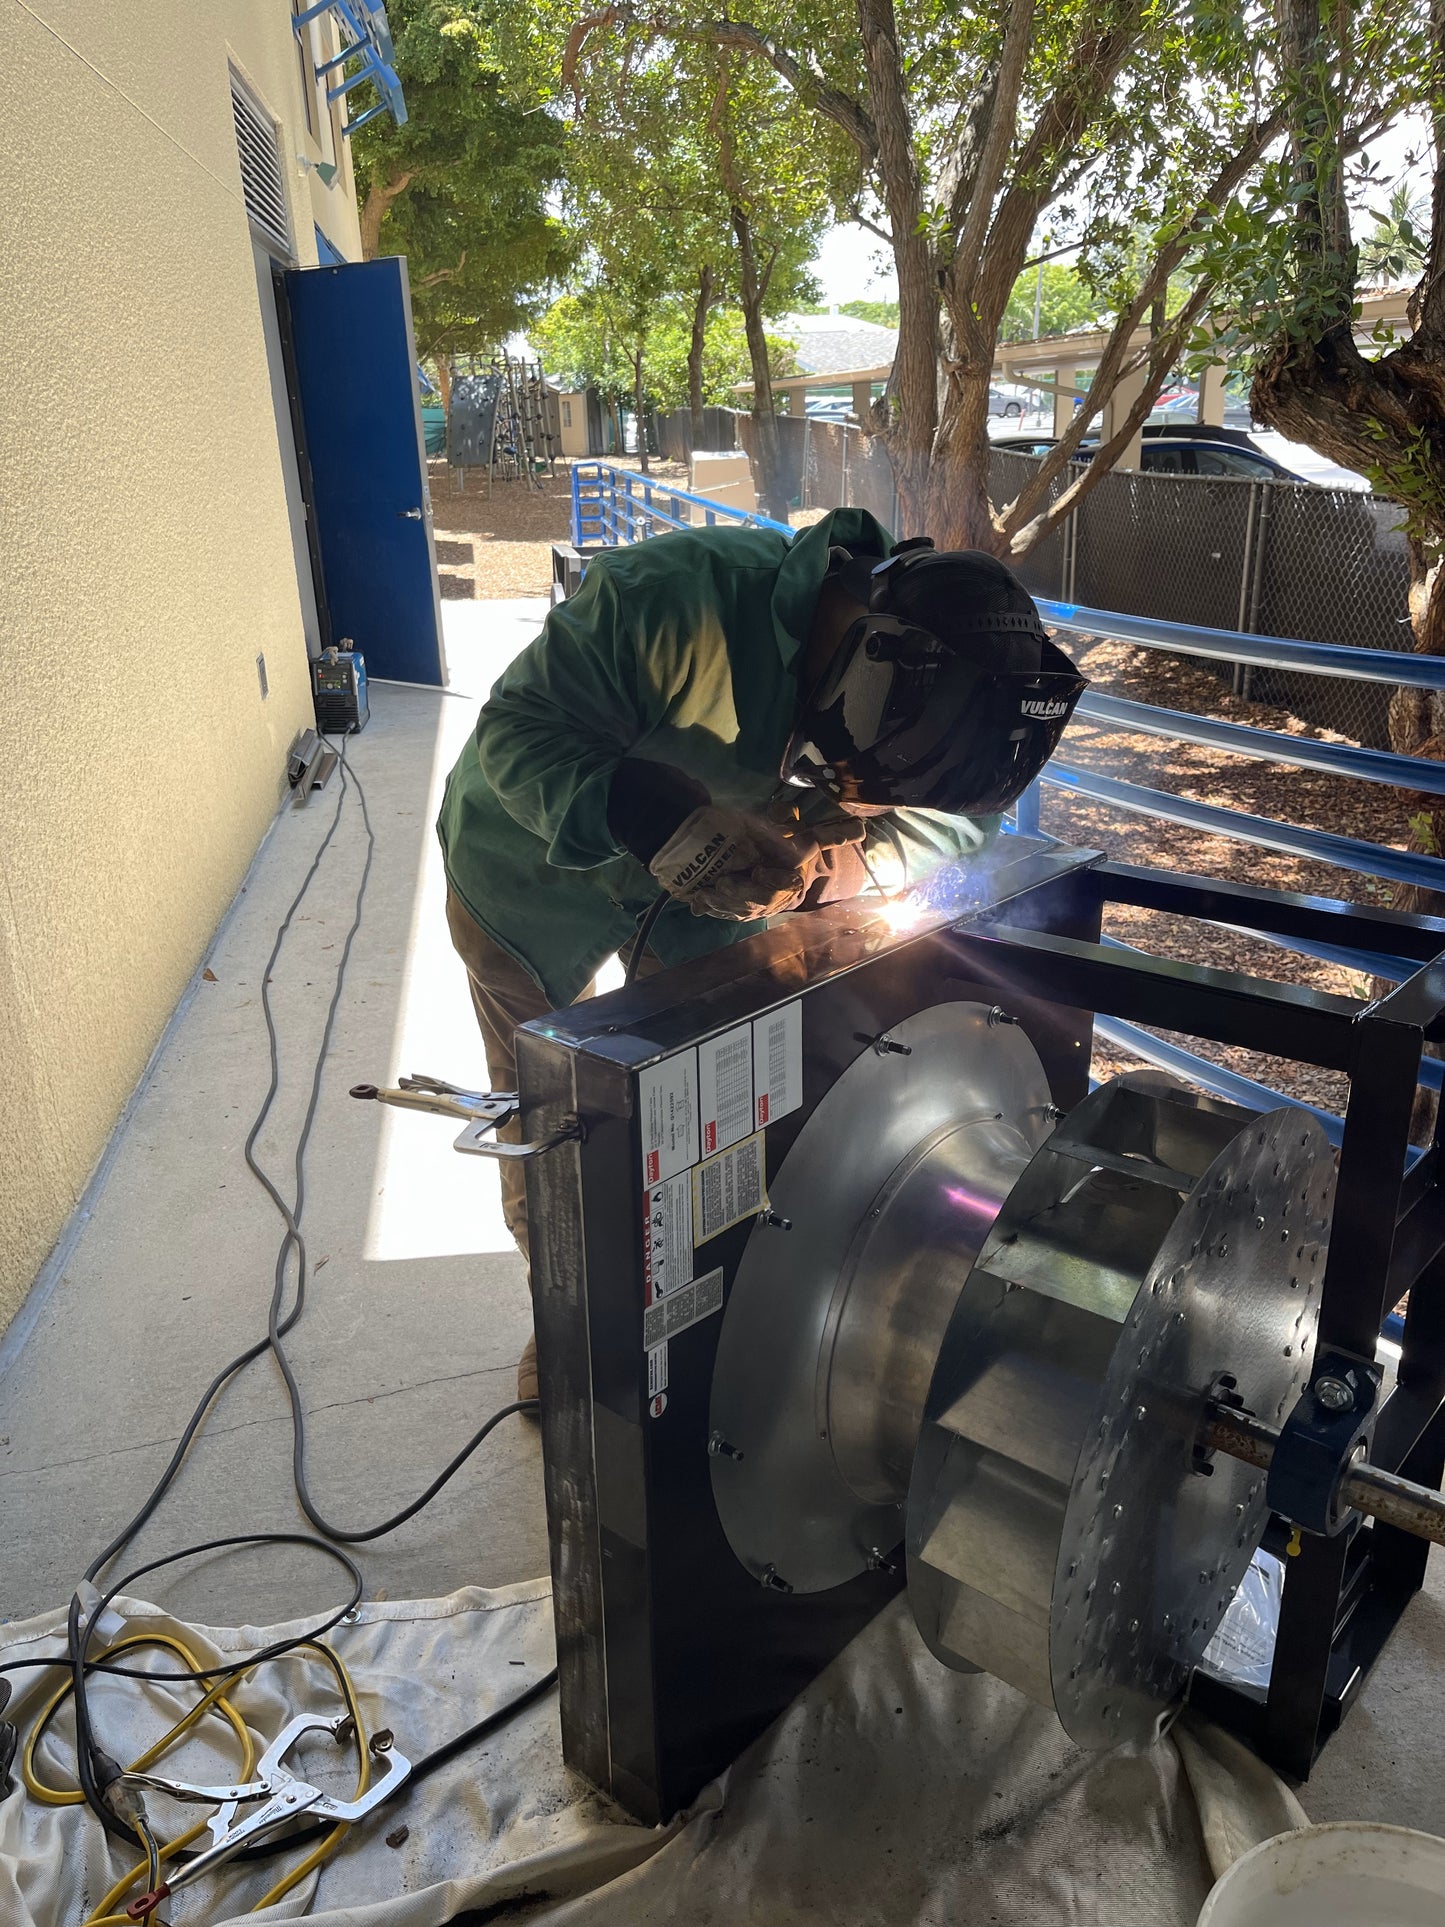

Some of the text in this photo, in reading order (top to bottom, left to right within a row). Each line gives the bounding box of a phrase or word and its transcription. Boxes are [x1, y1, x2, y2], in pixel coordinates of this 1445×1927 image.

[1020, 700, 1069, 715] VULCAN
[672, 832, 726, 887] VULCAN
[758, 1097, 766, 1124] Dayton
[647, 1153, 655, 1184] Dayton
[644, 1216, 652, 1284] DANGER
